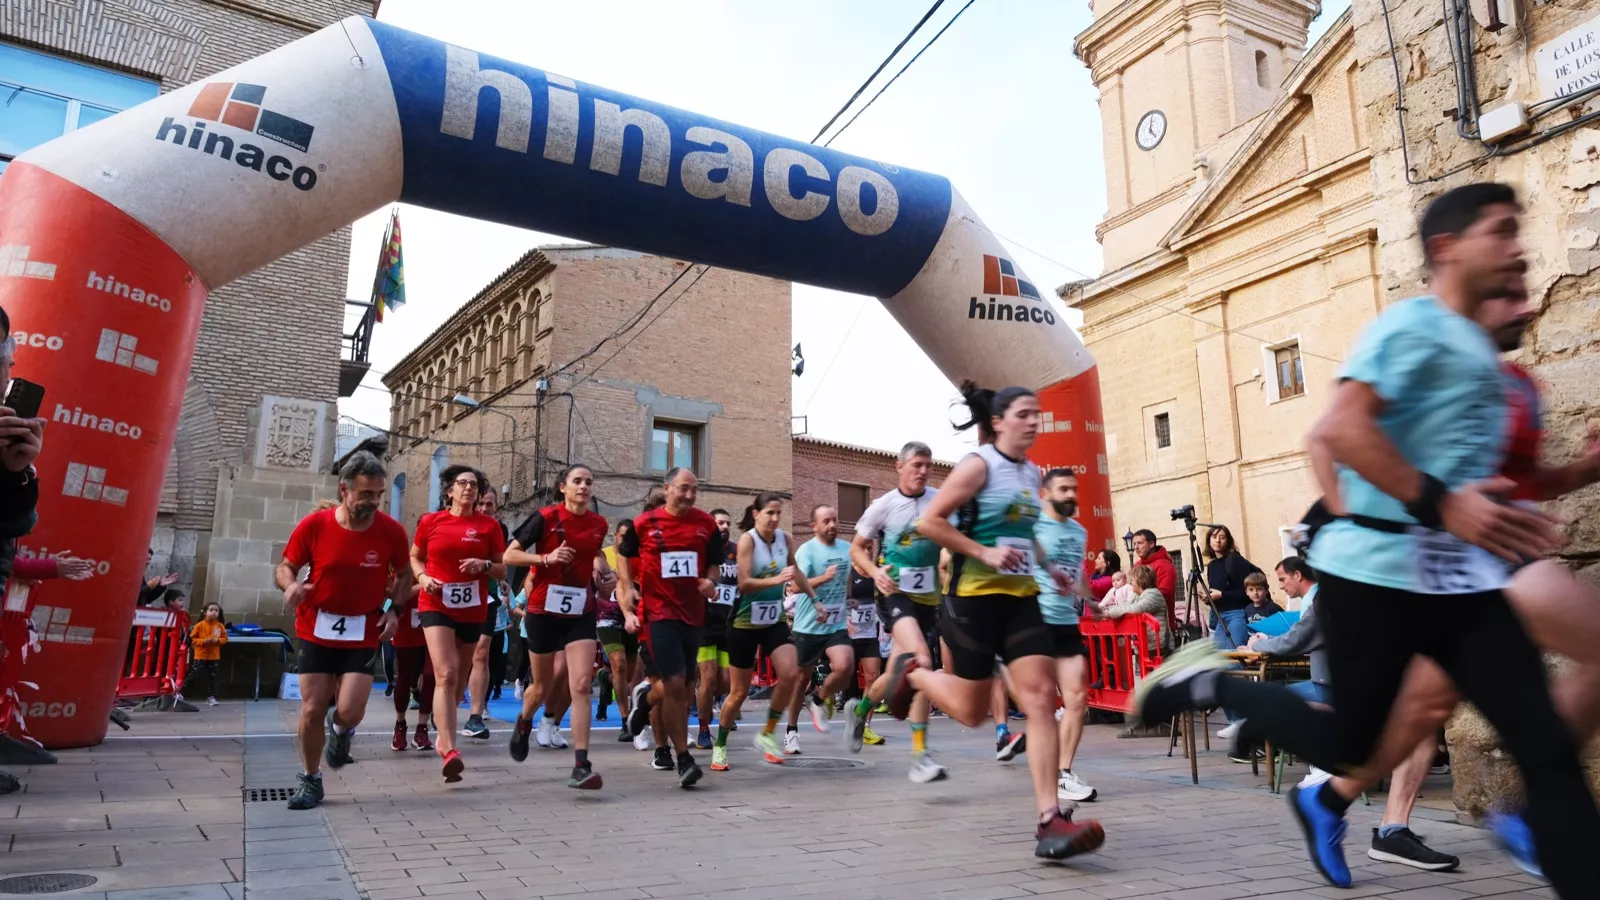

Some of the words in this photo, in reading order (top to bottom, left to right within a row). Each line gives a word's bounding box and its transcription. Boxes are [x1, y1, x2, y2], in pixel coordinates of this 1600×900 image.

[1553, 32, 1596, 60] CALLE
[1555, 63, 1571, 79] DE
[1575, 48, 1600, 70] LOS
[258, 128, 306, 151] Constructora
[86, 271, 172, 312] hinaco
[968, 297, 1056, 325] hinaco
[53, 403, 142, 440] hinaco
[669, 560, 690, 576] 41
[912, 573, 925, 589] 2
[450, 587, 472, 604] 58
[560, 596, 573, 613] 5
[759, 605, 777, 621] 70
[857, 610, 871, 622] 75
[331, 617, 347, 635] 4
